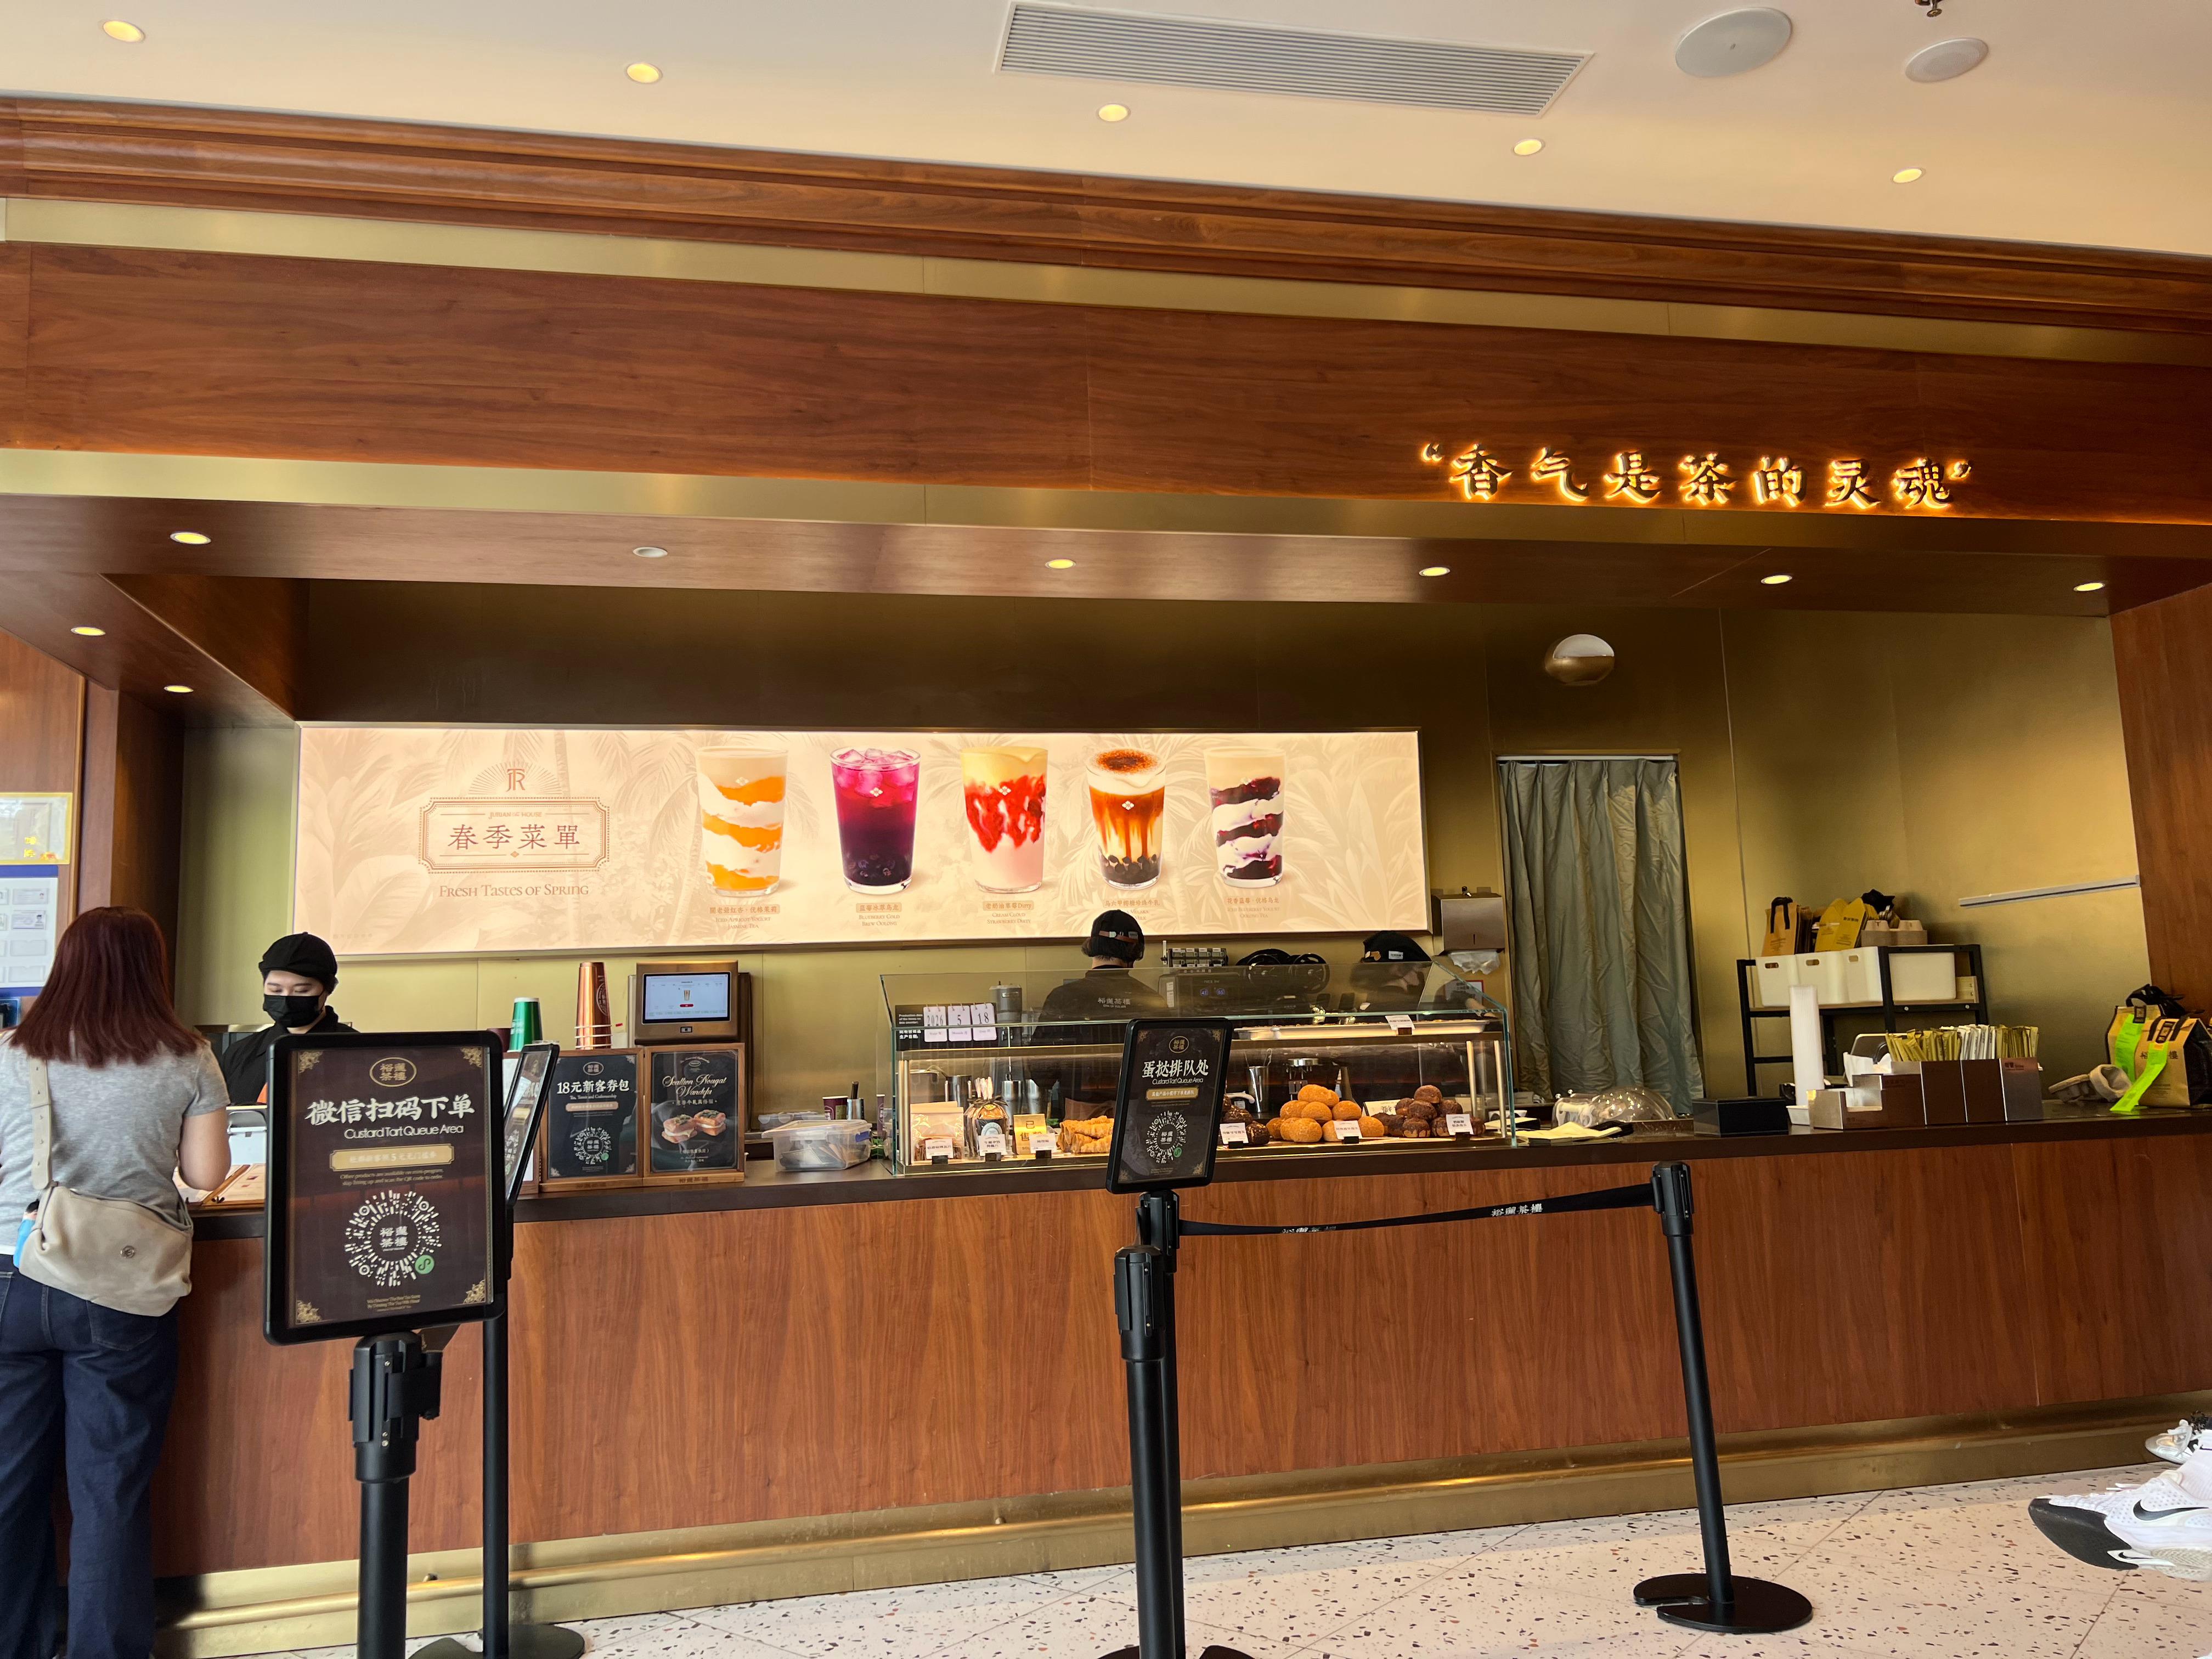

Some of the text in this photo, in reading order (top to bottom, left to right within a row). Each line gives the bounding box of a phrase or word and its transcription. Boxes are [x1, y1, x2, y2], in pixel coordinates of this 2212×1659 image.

[447, 824, 580, 850] 春季菜單
[927, 1015, 944, 1026] 2026
[957, 1015, 961, 1025] 5
[978, 1012, 990, 1024] 18
[1142, 1059, 1209, 1078] 蛋挞排队处
[557, 1079, 630, 1094] 18元新客券包
[696, 1074, 727, 1087] Nougat
[304, 1093, 475, 1126] 微信扫码下单
[344, 1124, 464, 1139] Custard Tart Queue Area
